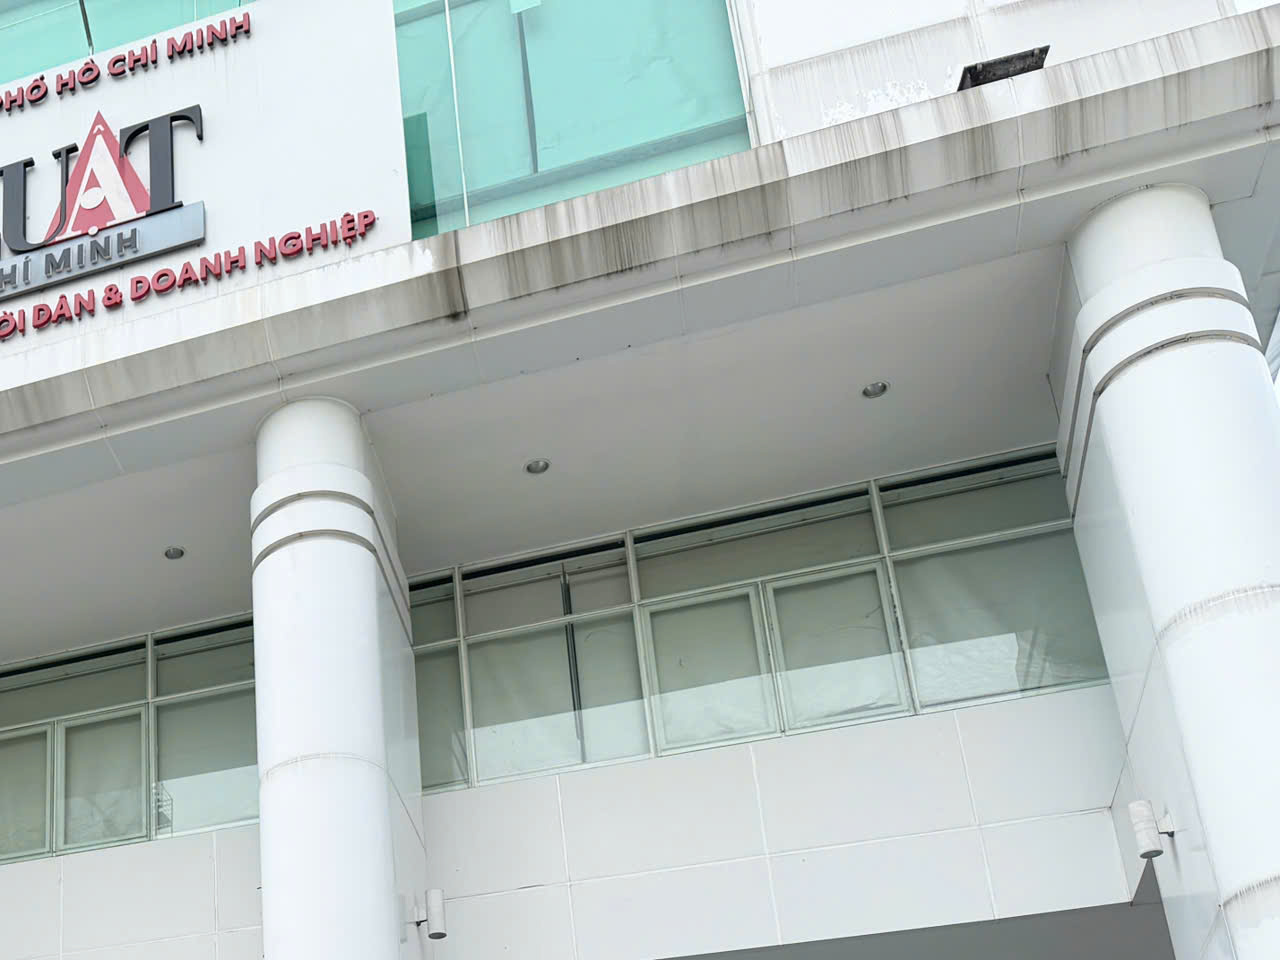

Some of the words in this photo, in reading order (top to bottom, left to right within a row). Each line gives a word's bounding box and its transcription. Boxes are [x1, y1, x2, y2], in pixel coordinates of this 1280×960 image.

[55, 58, 100, 96] HỒ
[107, 39, 158, 78] CHÍ
[167, 11, 252, 59] MINH
[32, 283, 95, 330] DÂN
[102, 284, 123, 309] &
[130, 246, 246, 302] DOANH
[254, 208, 377, 266] NGHIỆP
[44, 227, 141, 277] MINH
